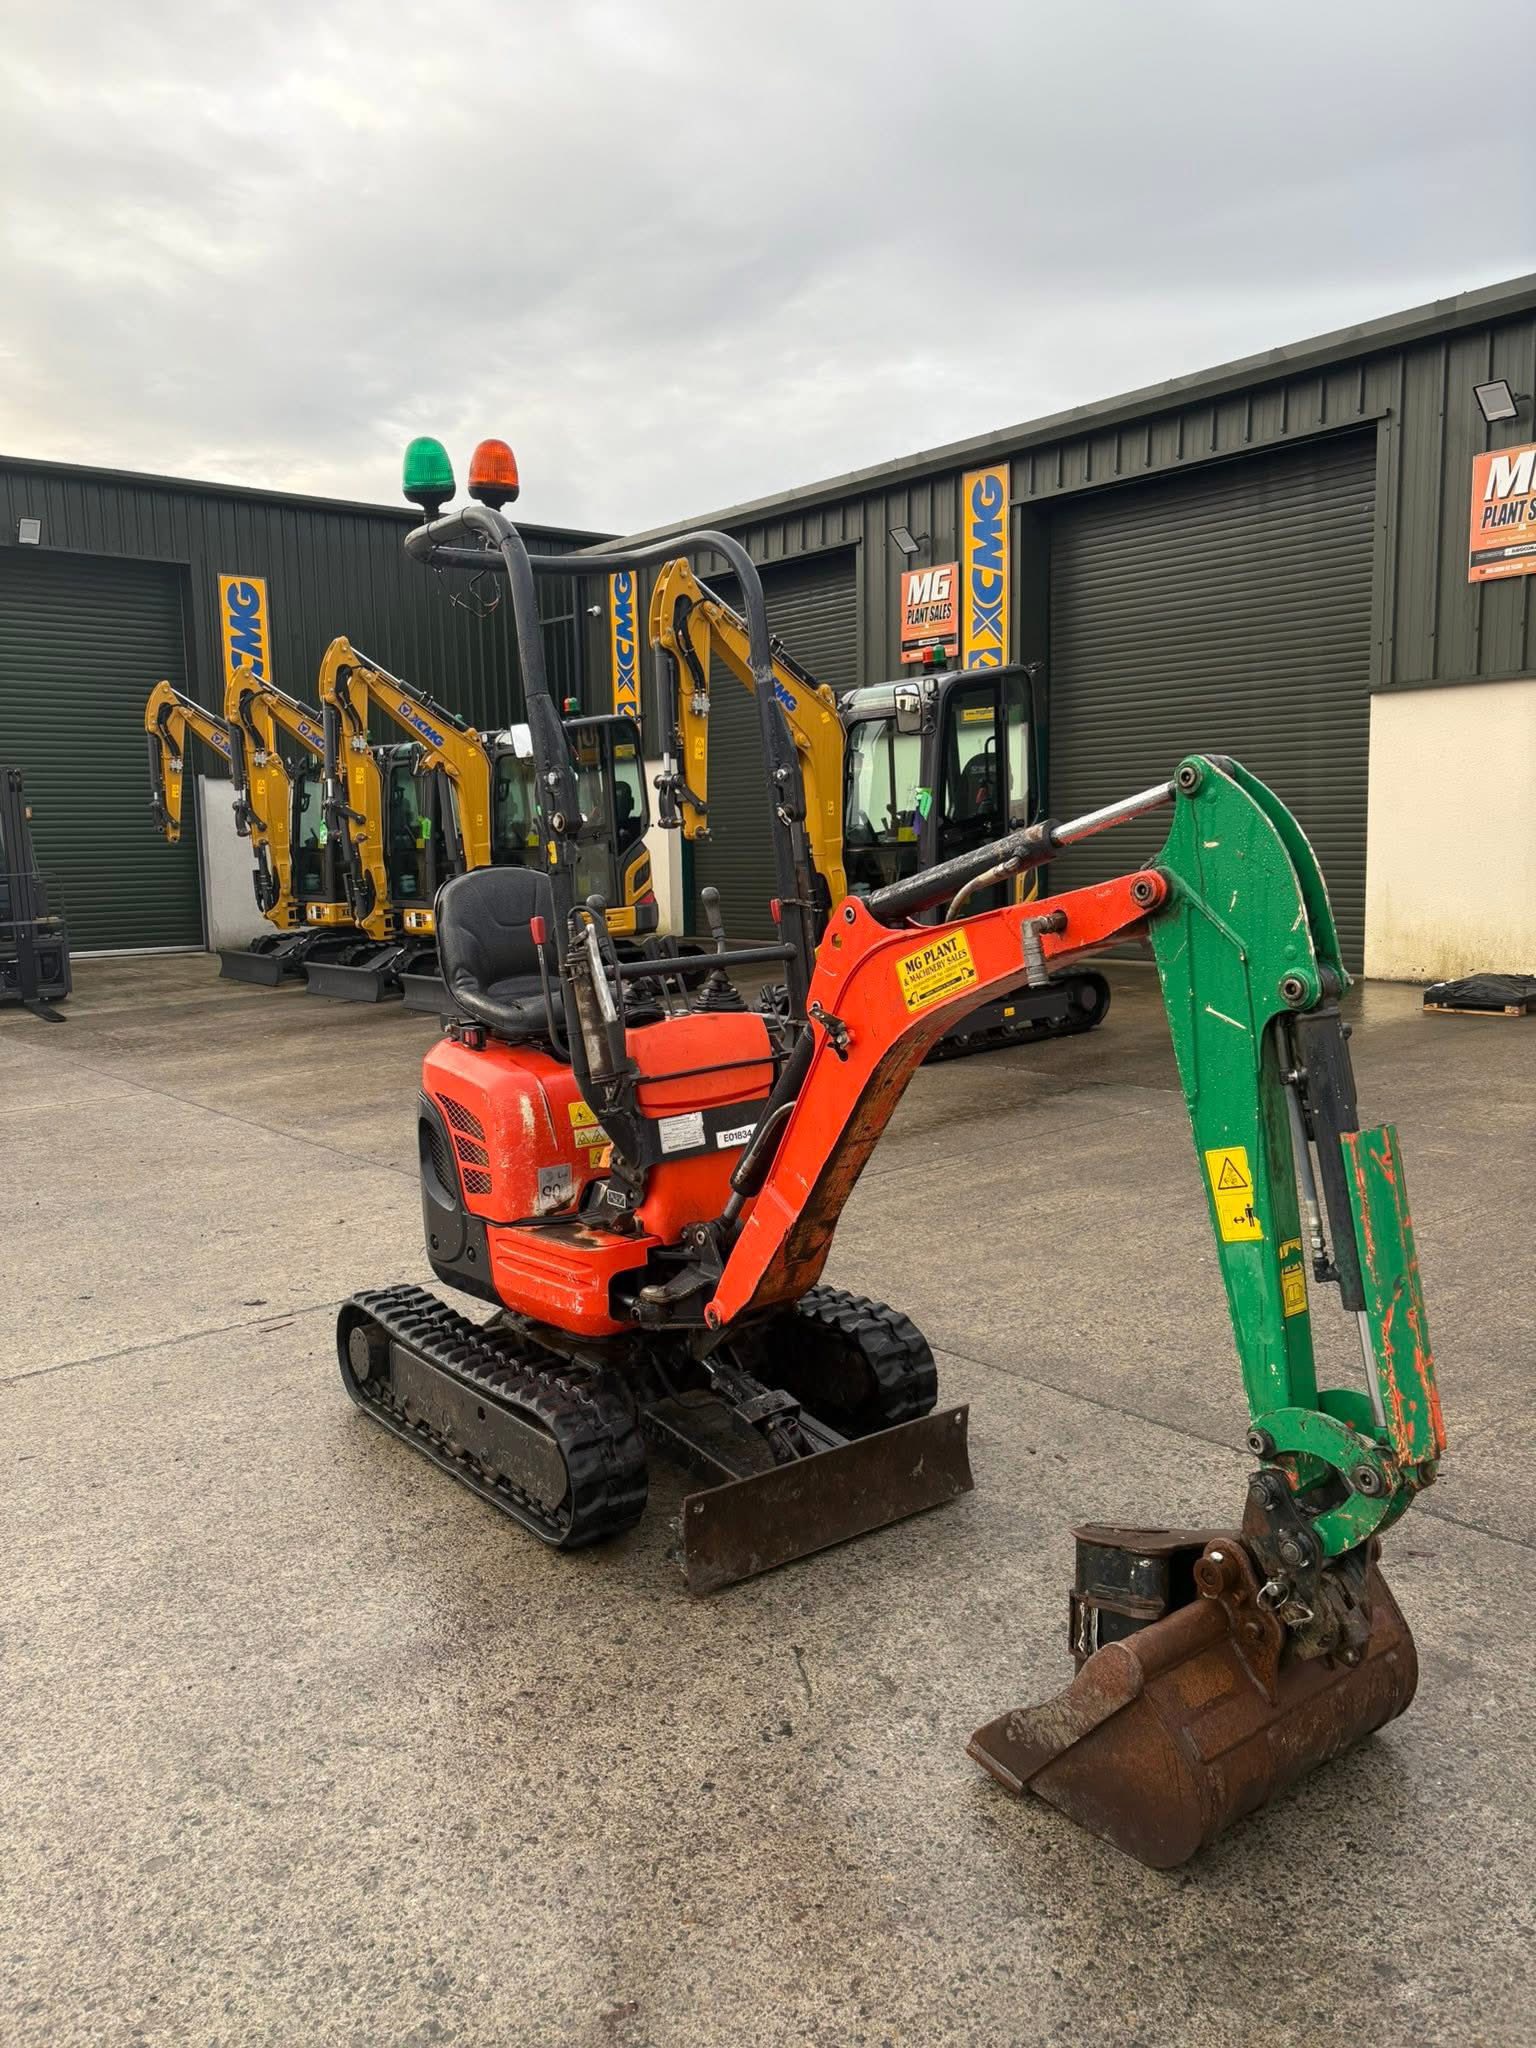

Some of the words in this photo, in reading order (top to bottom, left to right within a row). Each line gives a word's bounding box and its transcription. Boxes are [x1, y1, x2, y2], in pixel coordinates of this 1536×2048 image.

[1483, 450, 1536, 502] M
[1482, 501, 1527, 528] PLANT
[972, 475, 1003, 646] XCMG
[907, 568, 952, 607] MG
[227, 581, 264, 677] CMG
[907, 606, 929, 624] PLANT
[929, 602, 952, 622] SALES
[614, 571, 635, 697] XCMG
[772, 677, 798, 712] MG
[409, 713, 444, 747] XCMG
[904, 978, 909, 986] &
[910, 959, 945, 982] MACHINERY
[947, 948, 967, 964] SALES
[905, 956, 923, 975] MG
[924, 937, 957, 965] PLANT
[724, 1129, 753, 1143] E01834
